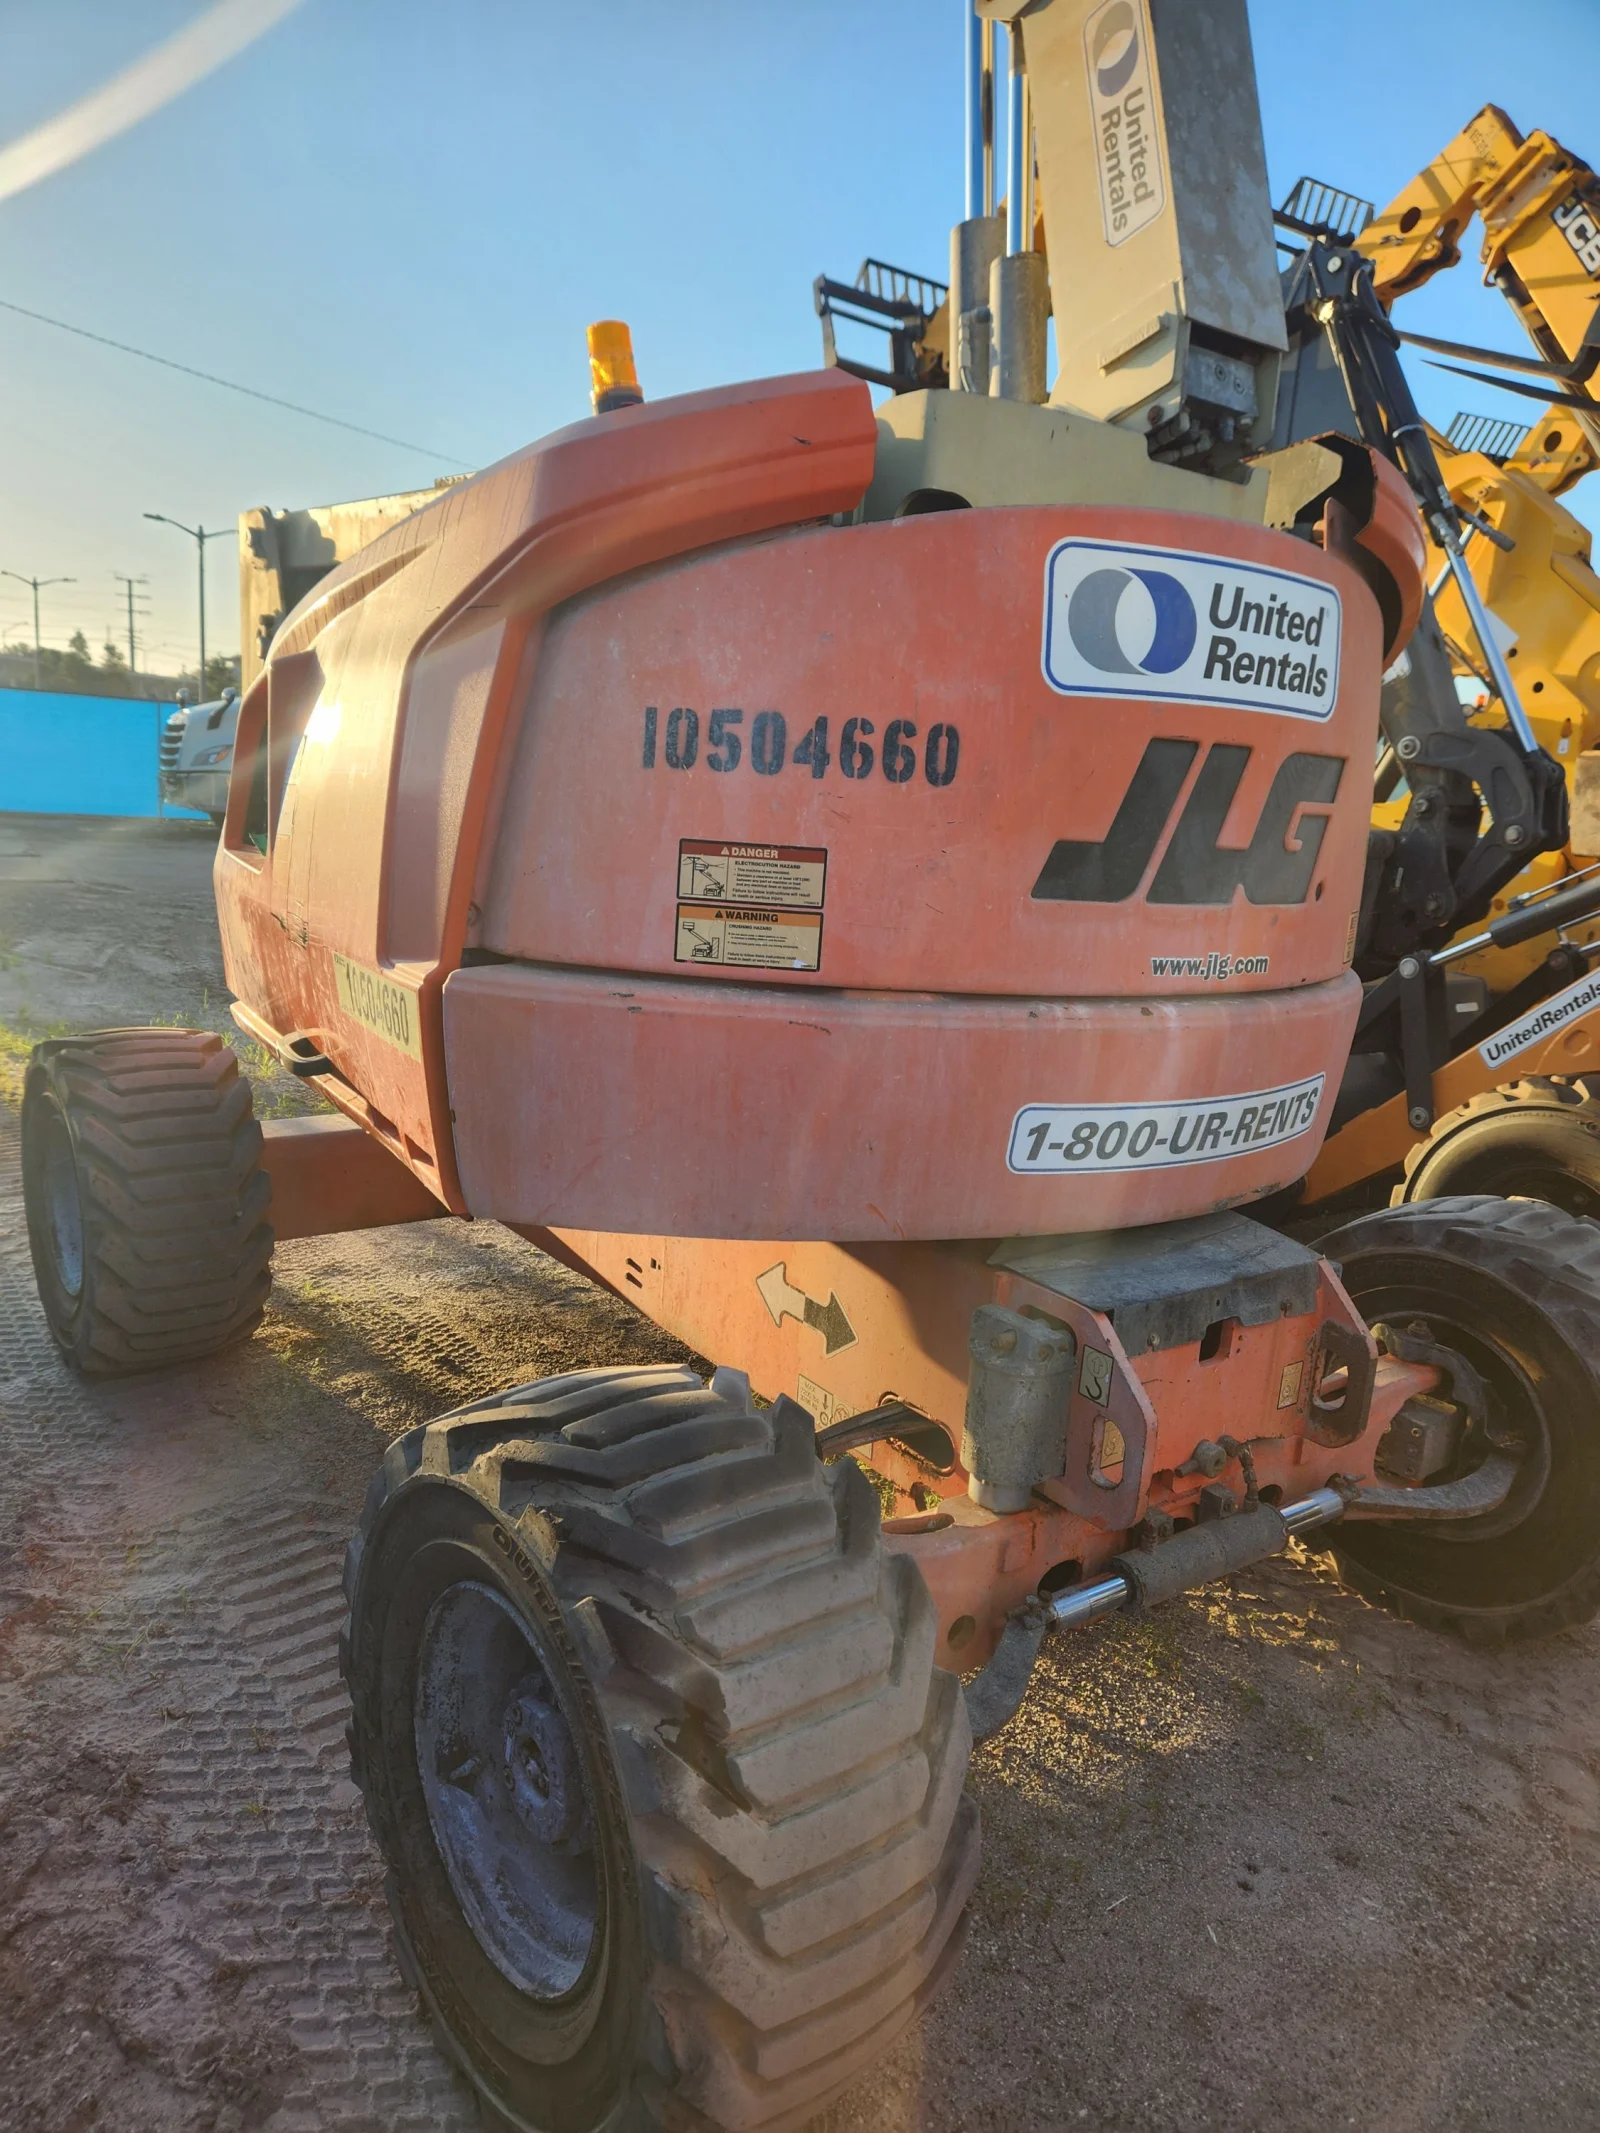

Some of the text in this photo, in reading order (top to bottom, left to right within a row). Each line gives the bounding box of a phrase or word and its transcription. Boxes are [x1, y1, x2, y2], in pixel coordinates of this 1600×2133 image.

[1101, 105, 1131, 232] Rentals
[1123, 87, 1155, 205] United
[1553, 204, 1600, 272] JCB
[1209, 583, 1325, 647] United
[1203, 635, 1328, 698] Rentals
[643, 707, 960, 787] 10504660
[731, 847, 779, 859] DANGER
[1030, 739, 1348, 906] JLG
[725, 910, 779, 922] WARNING
[1151, 954, 1269, 980] www.jlg.com
[1025, 1086, 1320, 1162] 1-800-UR-RENTS
